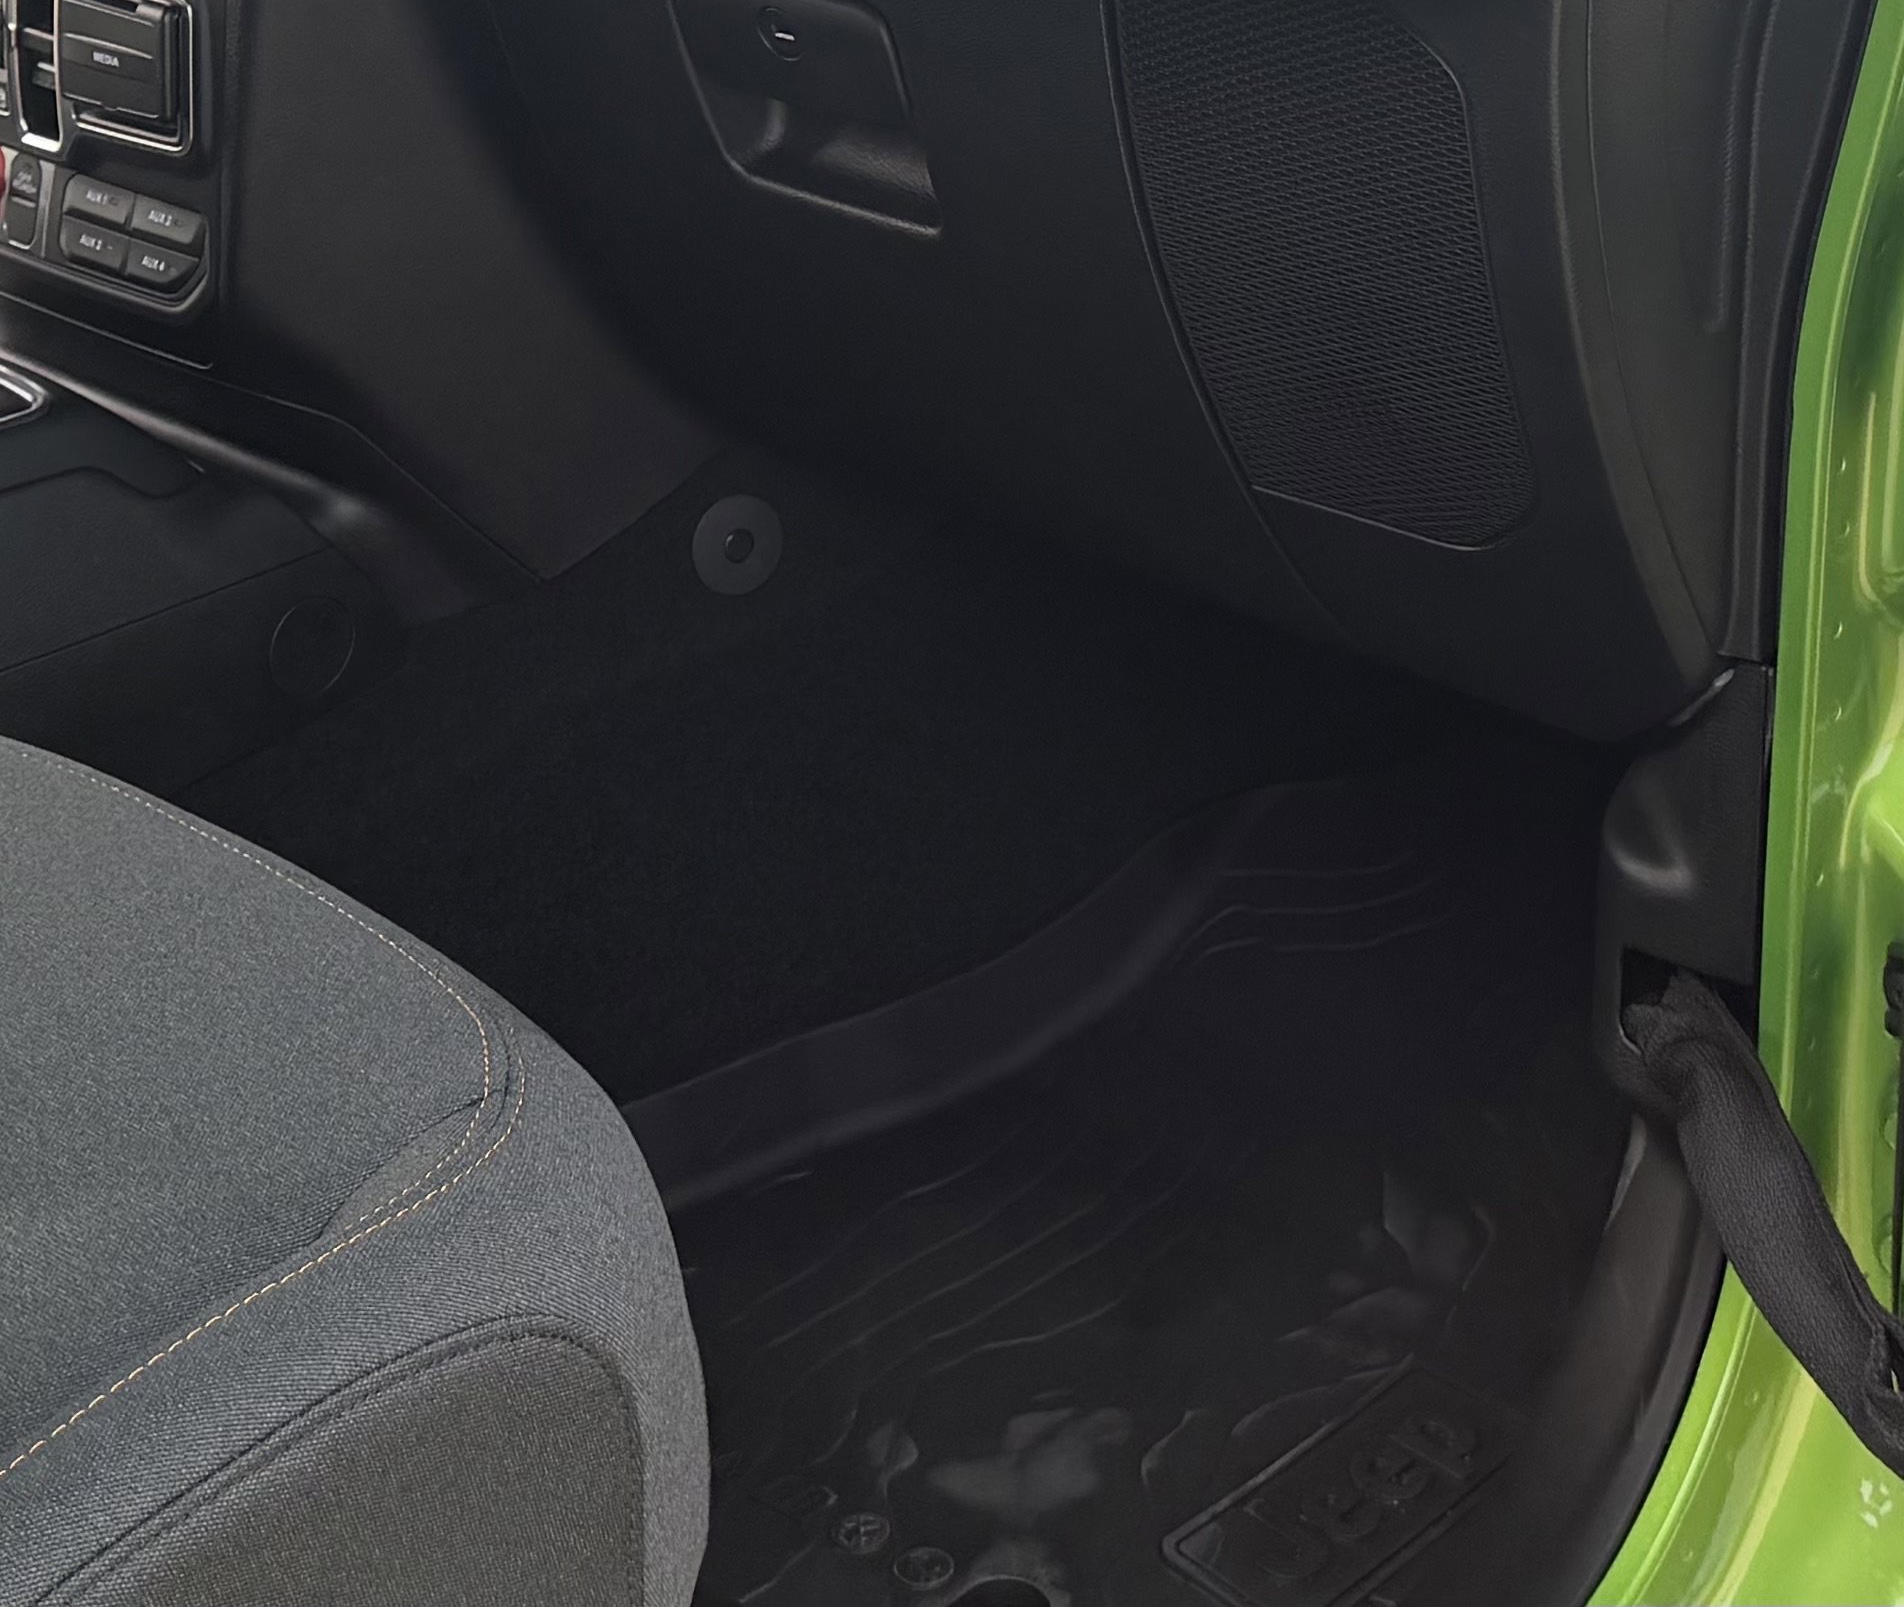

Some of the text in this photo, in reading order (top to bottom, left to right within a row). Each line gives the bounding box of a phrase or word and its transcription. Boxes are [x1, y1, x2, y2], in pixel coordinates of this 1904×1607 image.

[93, 51, 120, 67] MEDIA
[86, 189, 108, 205] AUX 1
[148, 210, 165, 223] AUX
[80, 234, 96, 247] AUX
[141, 255, 158, 269] AUX
